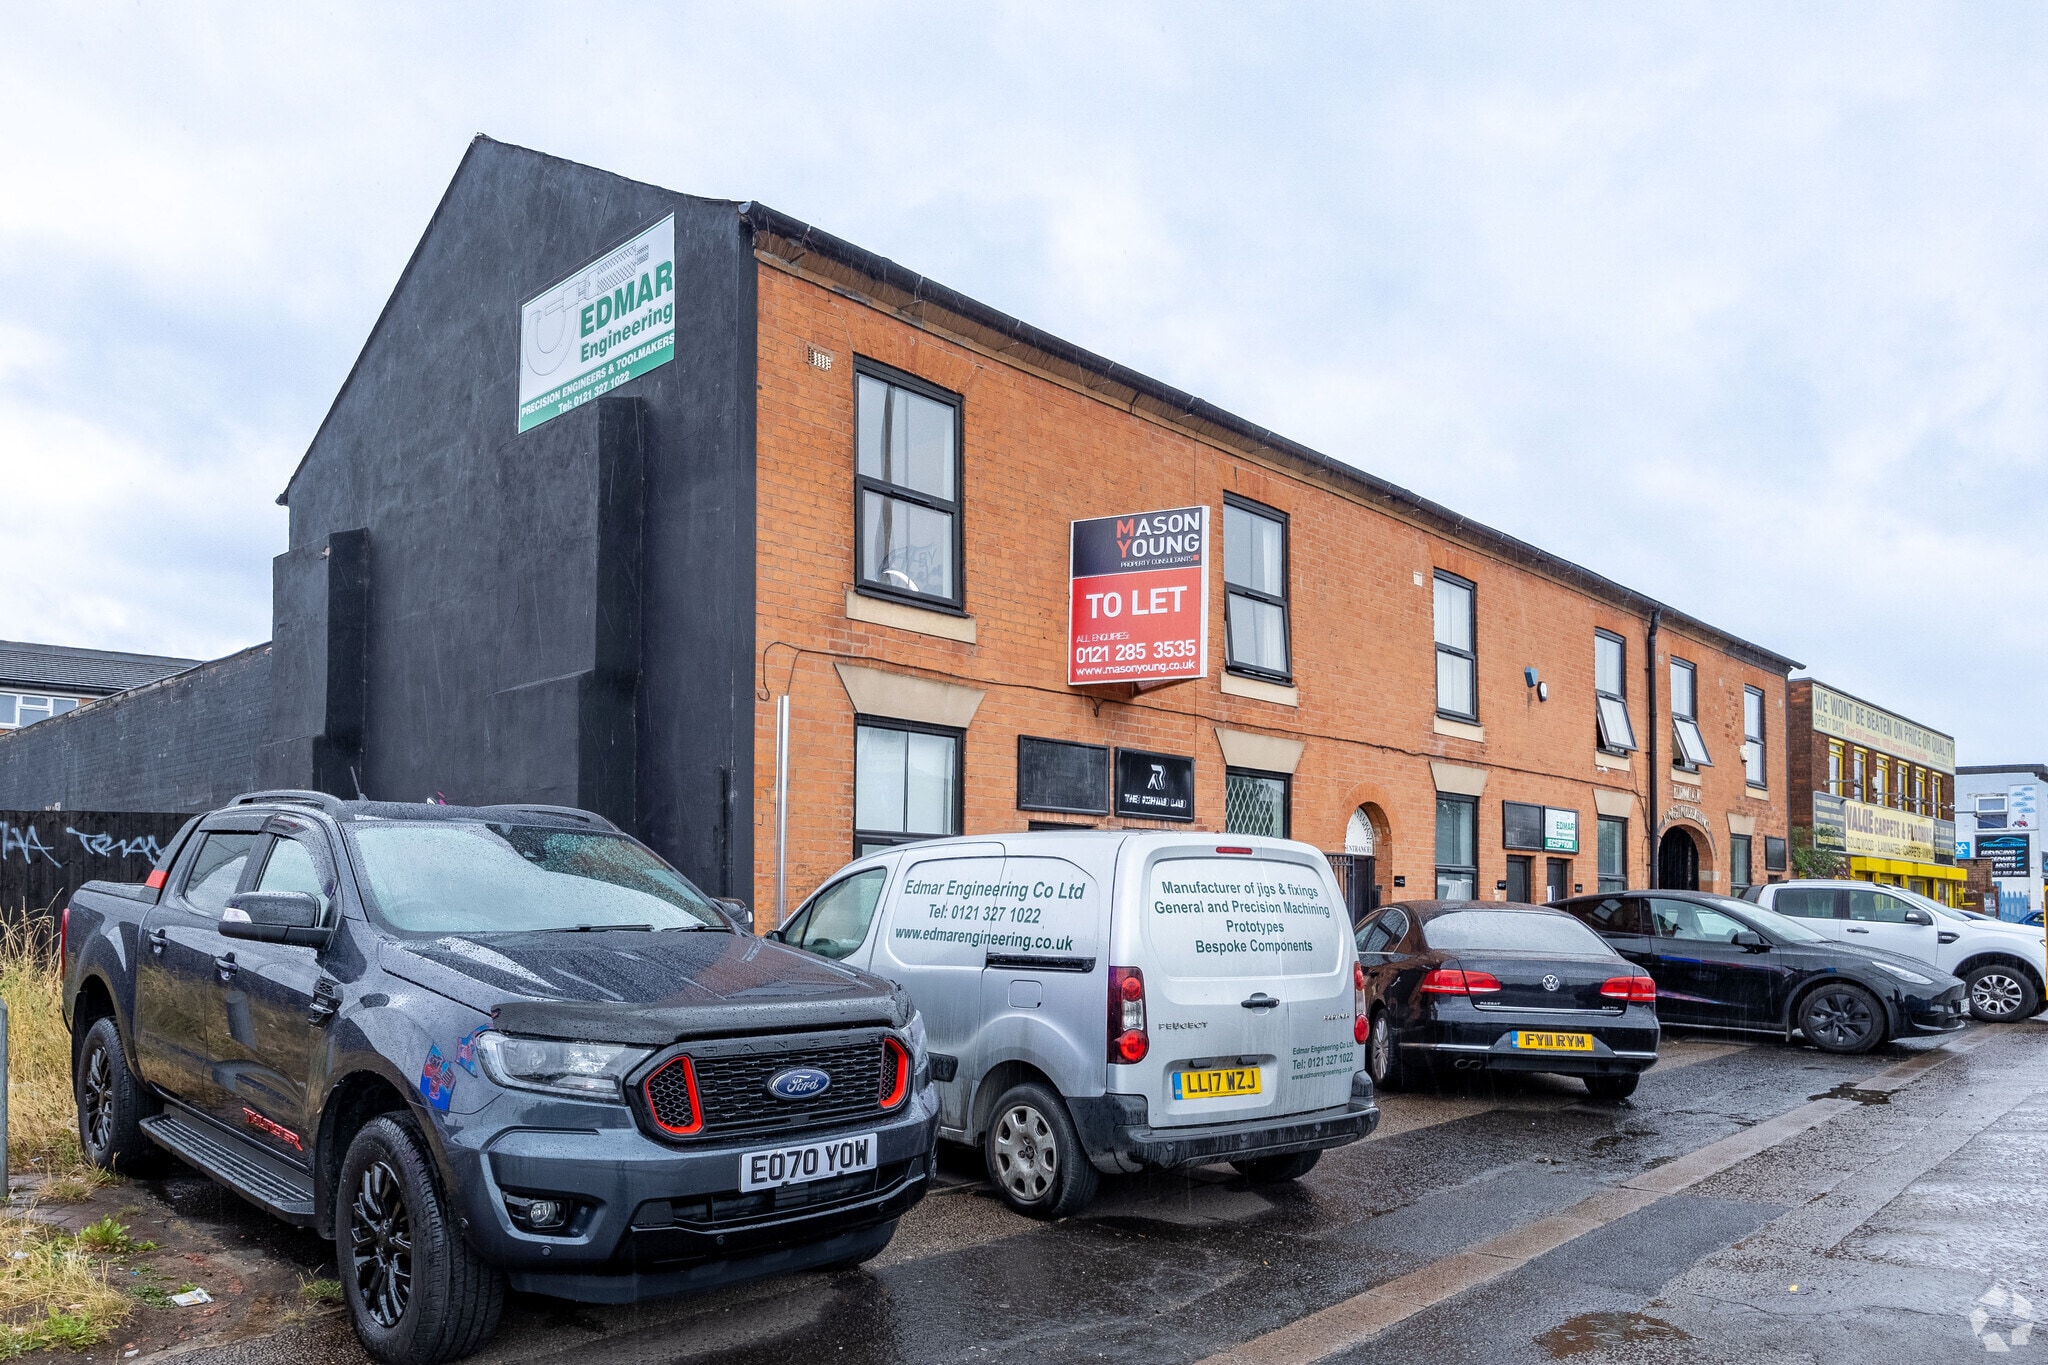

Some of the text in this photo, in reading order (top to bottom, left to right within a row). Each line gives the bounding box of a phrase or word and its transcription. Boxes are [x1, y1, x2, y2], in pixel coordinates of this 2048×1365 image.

[580, 260, 673, 339] EDMAR
[581, 302, 673, 363] Engineering
[522, 332, 675, 418] PRECISION ENGINEERS & TOOLMAKERS
[558, 370, 630, 413] Tel: 0121 327 1022
[1116, 512, 1200, 538] MASON
[1116, 533, 1200, 558] YOUNG
[1121, 555, 1193, 568] PROPERTY CONSULTANTS
[1086, 586, 1188, 619] TO LET
[1076, 634, 1090, 643] ALL
[1076, 639, 1196, 663] 0121 285 3535
[1075, 659, 1195, 676] www.masonyoung.co.uk
[1815, 713, 1827, 728] OPEN
[1815, 689, 1827, 713] WE
[1830, 696, 1853, 722] WONT
[1855, 706, 1864, 726] BE
[1867, 711, 1892, 737] BEATEN
[1894, 721, 1903, 741] ON
[1905, 726, 1921, 747] PRICE
[1923, 732, 1931, 751] OR
[1932, 736, 1953, 759] QUALITY
[1124, 794, 1141, 804] THE
[1170, 799, 1187, 809] LAB
[1556, 821, 1575, 831] EDMAR
[1847, 804, 1874, 834] VALUE
[1874, 816, 1900, 838] CARPETS
[1902, 822, 1906, 840] &
[904, 879, 1086, 901] Edmar Engineering Co Ltd
[1161, 881, 1318, 899] Manufacturer of jigs & fixings
[929, 904, 1041, 924] Tel: 0121 327 1022
[1154, 900, 1330, 918] General and Precision Machining
[1226, 919, 1285, 936] Prototypes
[895, 927, 1074, 951] www.edmarengineering.co.uk
[1195, 939, 1313, 957] Bespoke Components
[1158, 1022, 1208, 1031] PEUGEOT
[1293, 1040, 1354, 1055] Edmar Engineering Co Ltd
[1525, 1034, 1585, 1048] FY11 RYM
[1293, 1052, 1354, 1070] Tel: 0121 327 1022
[786, 1074, 819, 1093] Ford
[1187, 1070, 1256, 1093] LL17 WZJ
[242, 1107, 303, 1151] THUNDER
[826, 1139, 869, 1171] YOW
